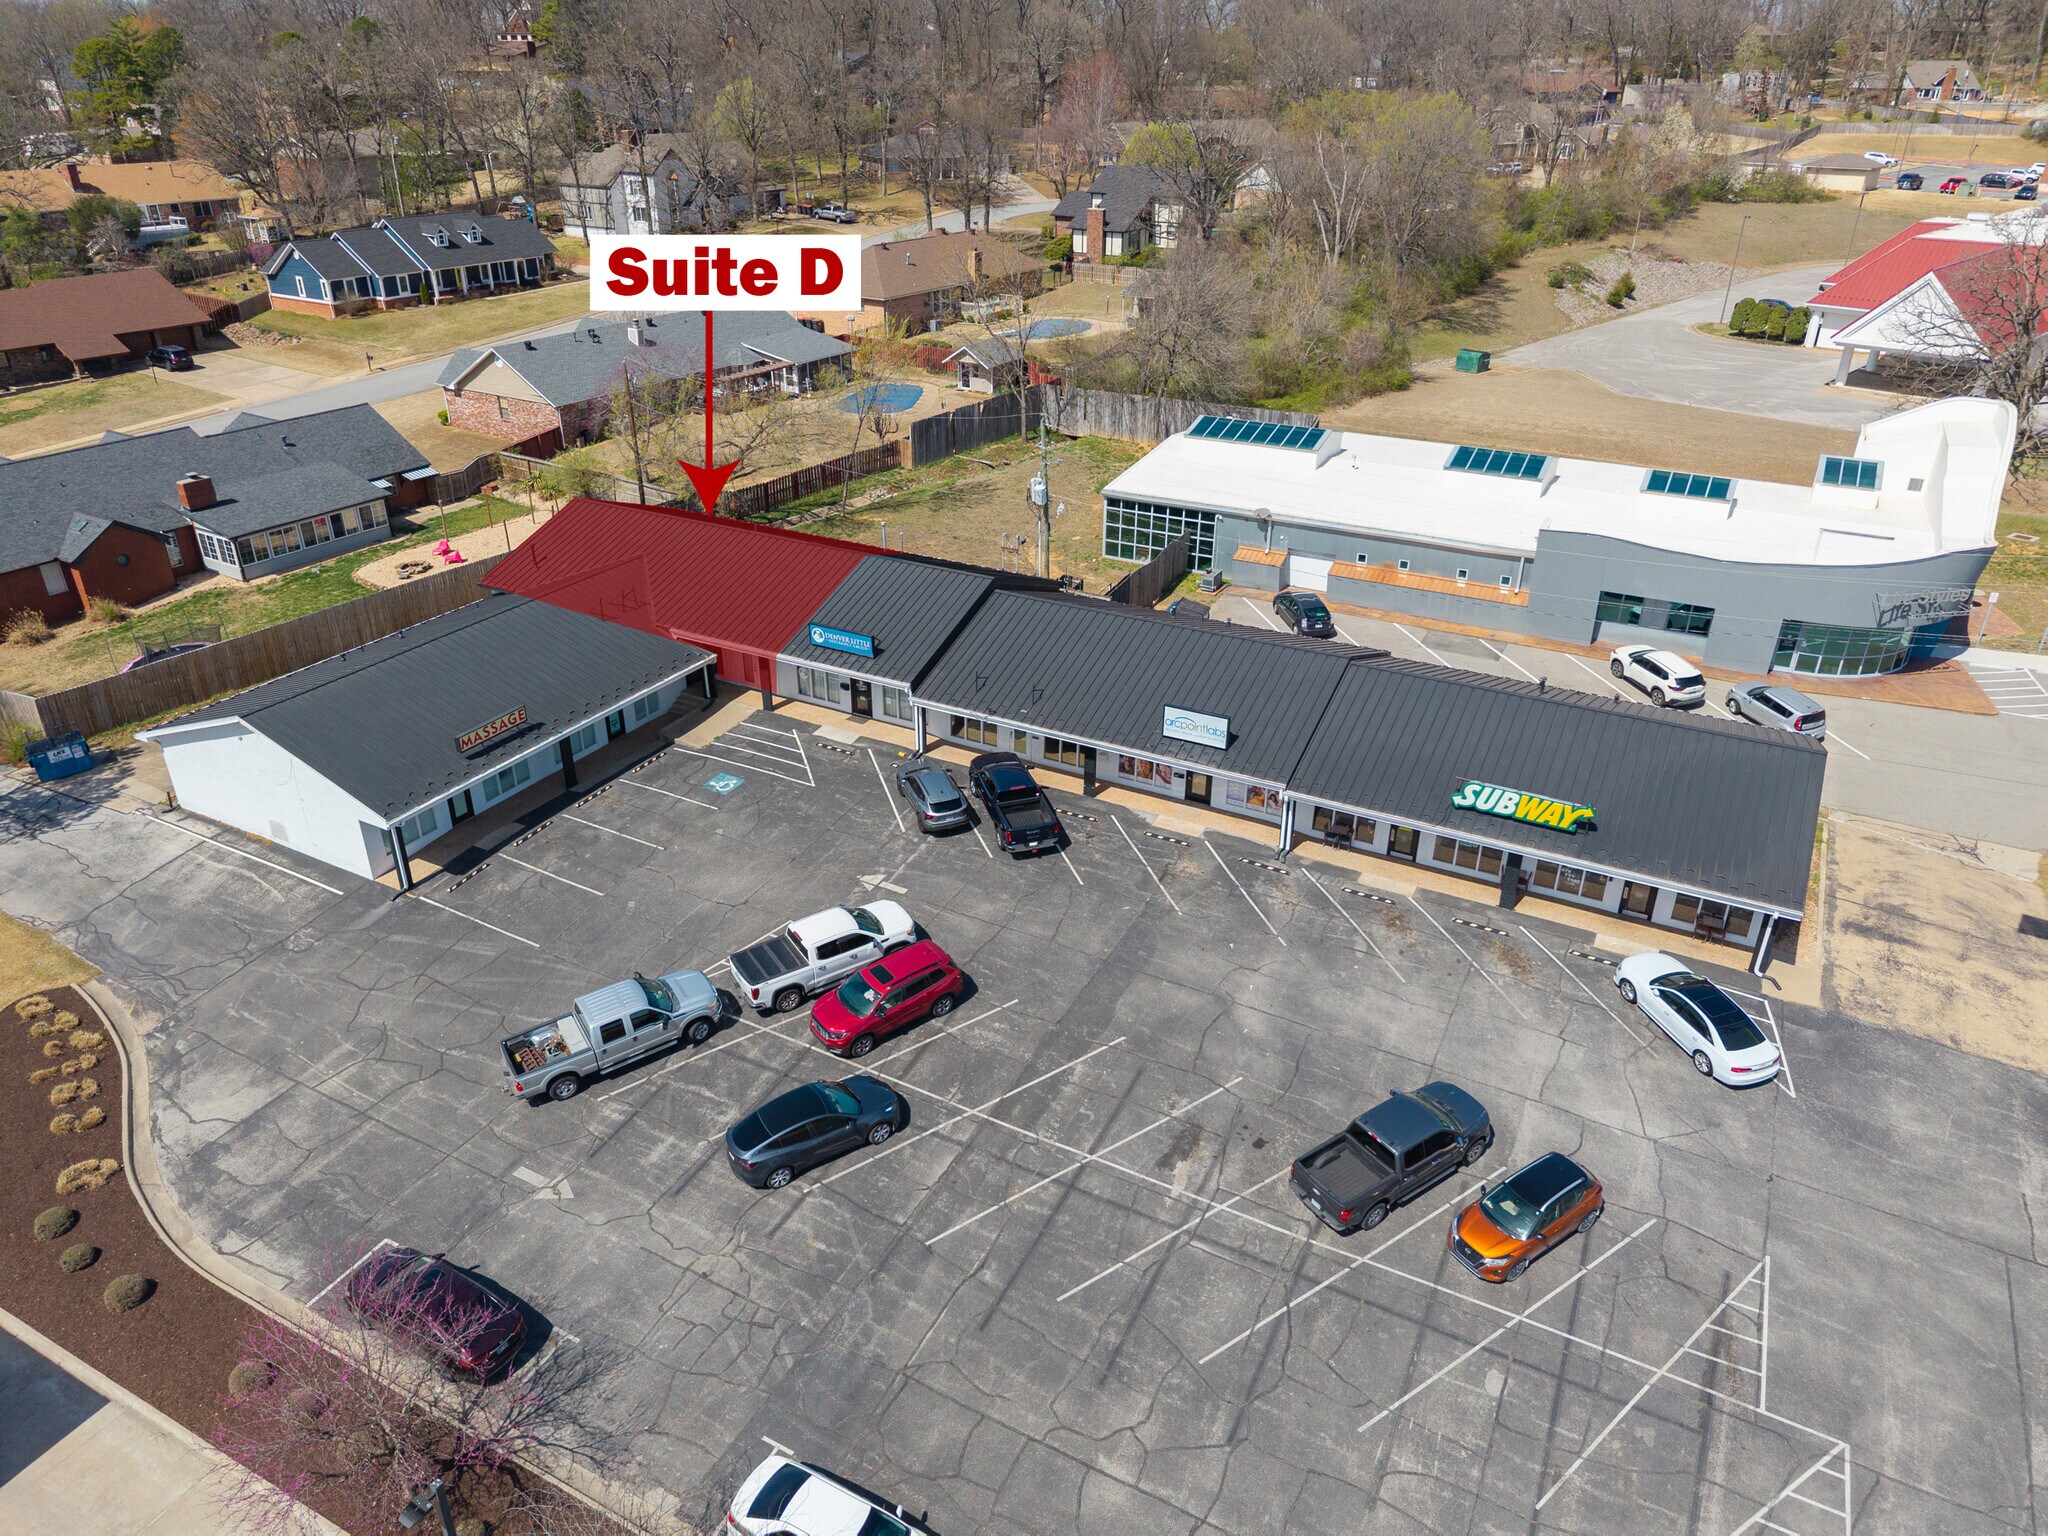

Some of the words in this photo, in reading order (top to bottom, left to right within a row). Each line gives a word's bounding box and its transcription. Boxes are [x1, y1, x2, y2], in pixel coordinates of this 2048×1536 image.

[1919, 588, 1971, 607] Styles
[825, 632, 849, 643] DENVER
[851, 638, 870, 648] LITTLE
[461, 709, 525, 749] MASSAGE
[1452, 784, 1594, 829] SUBWAY
